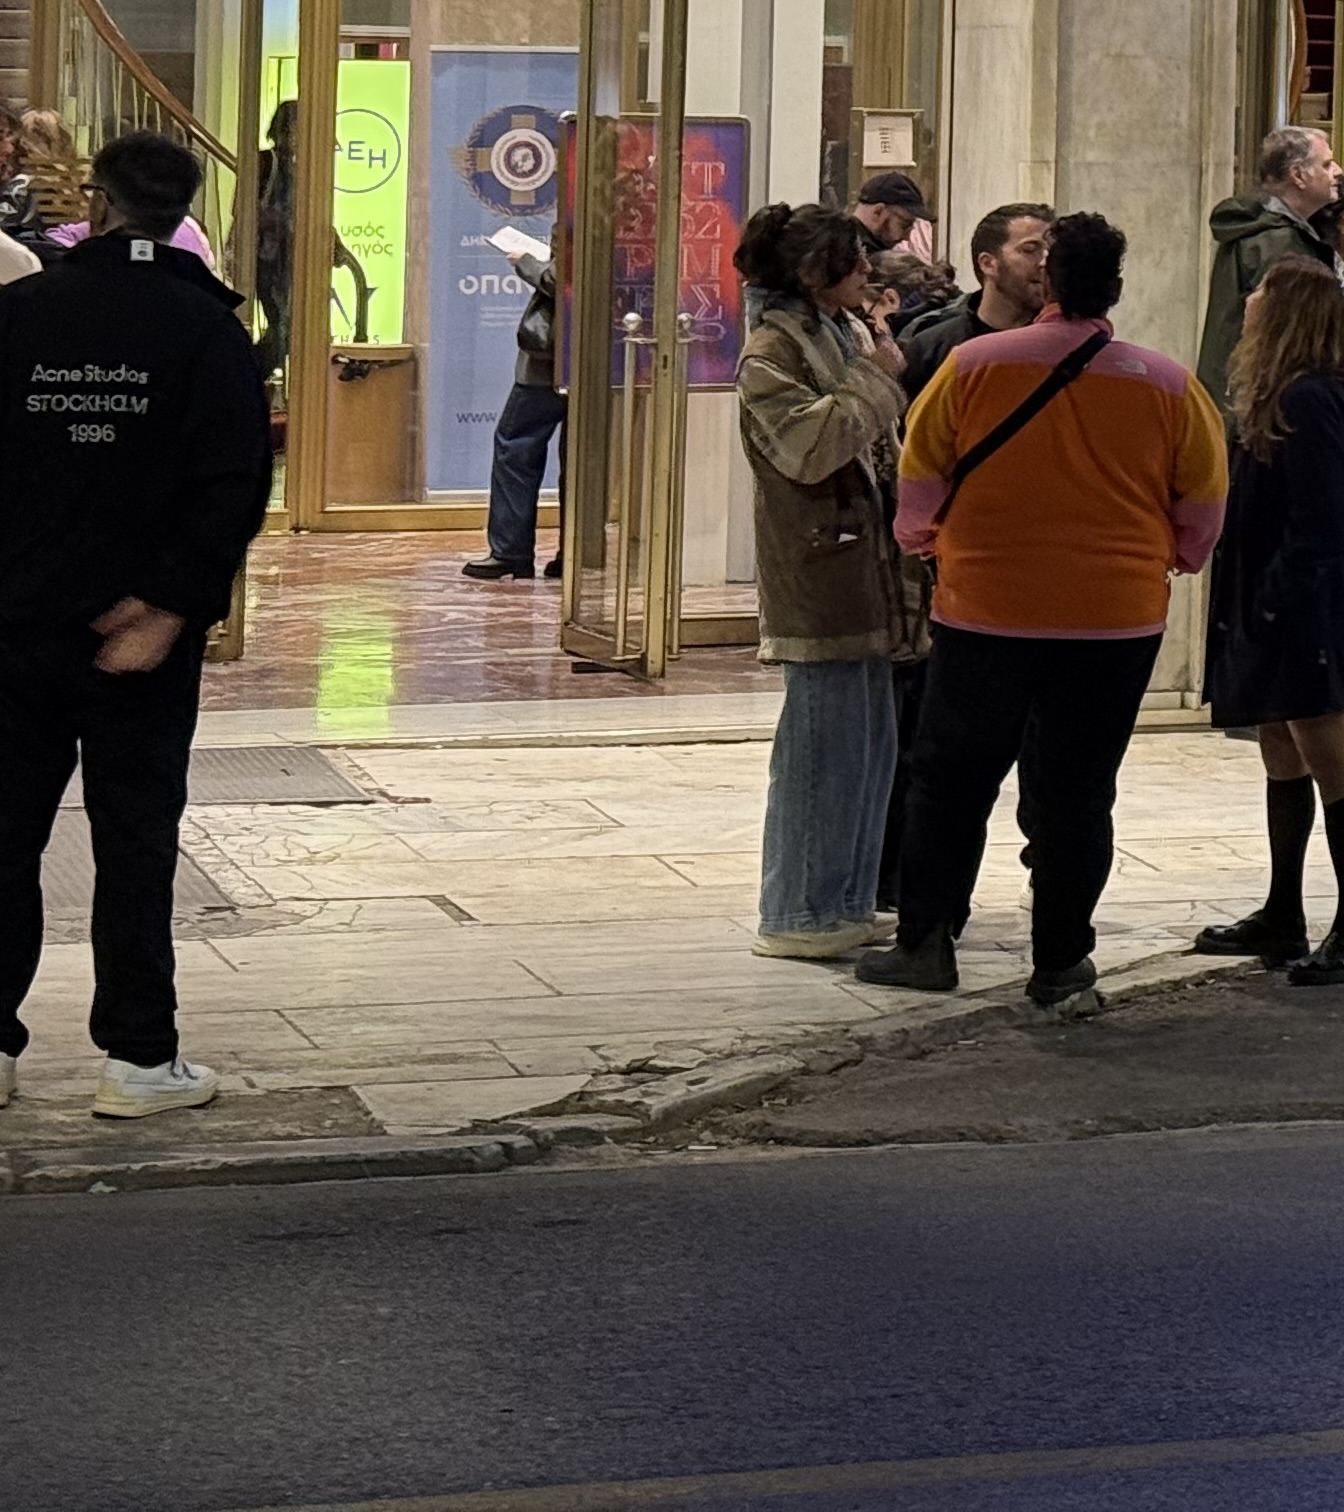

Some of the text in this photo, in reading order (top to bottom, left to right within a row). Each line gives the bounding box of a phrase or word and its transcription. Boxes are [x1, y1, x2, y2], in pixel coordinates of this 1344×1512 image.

[341, 221, 385, 240] υσός
[351, 241, 394, 259] ηγός
[31, 363, 150, 384] Acne Studios
[26, 393, 149, 415] STOCKHOLM
[67, 423, 116, 443] 1996
